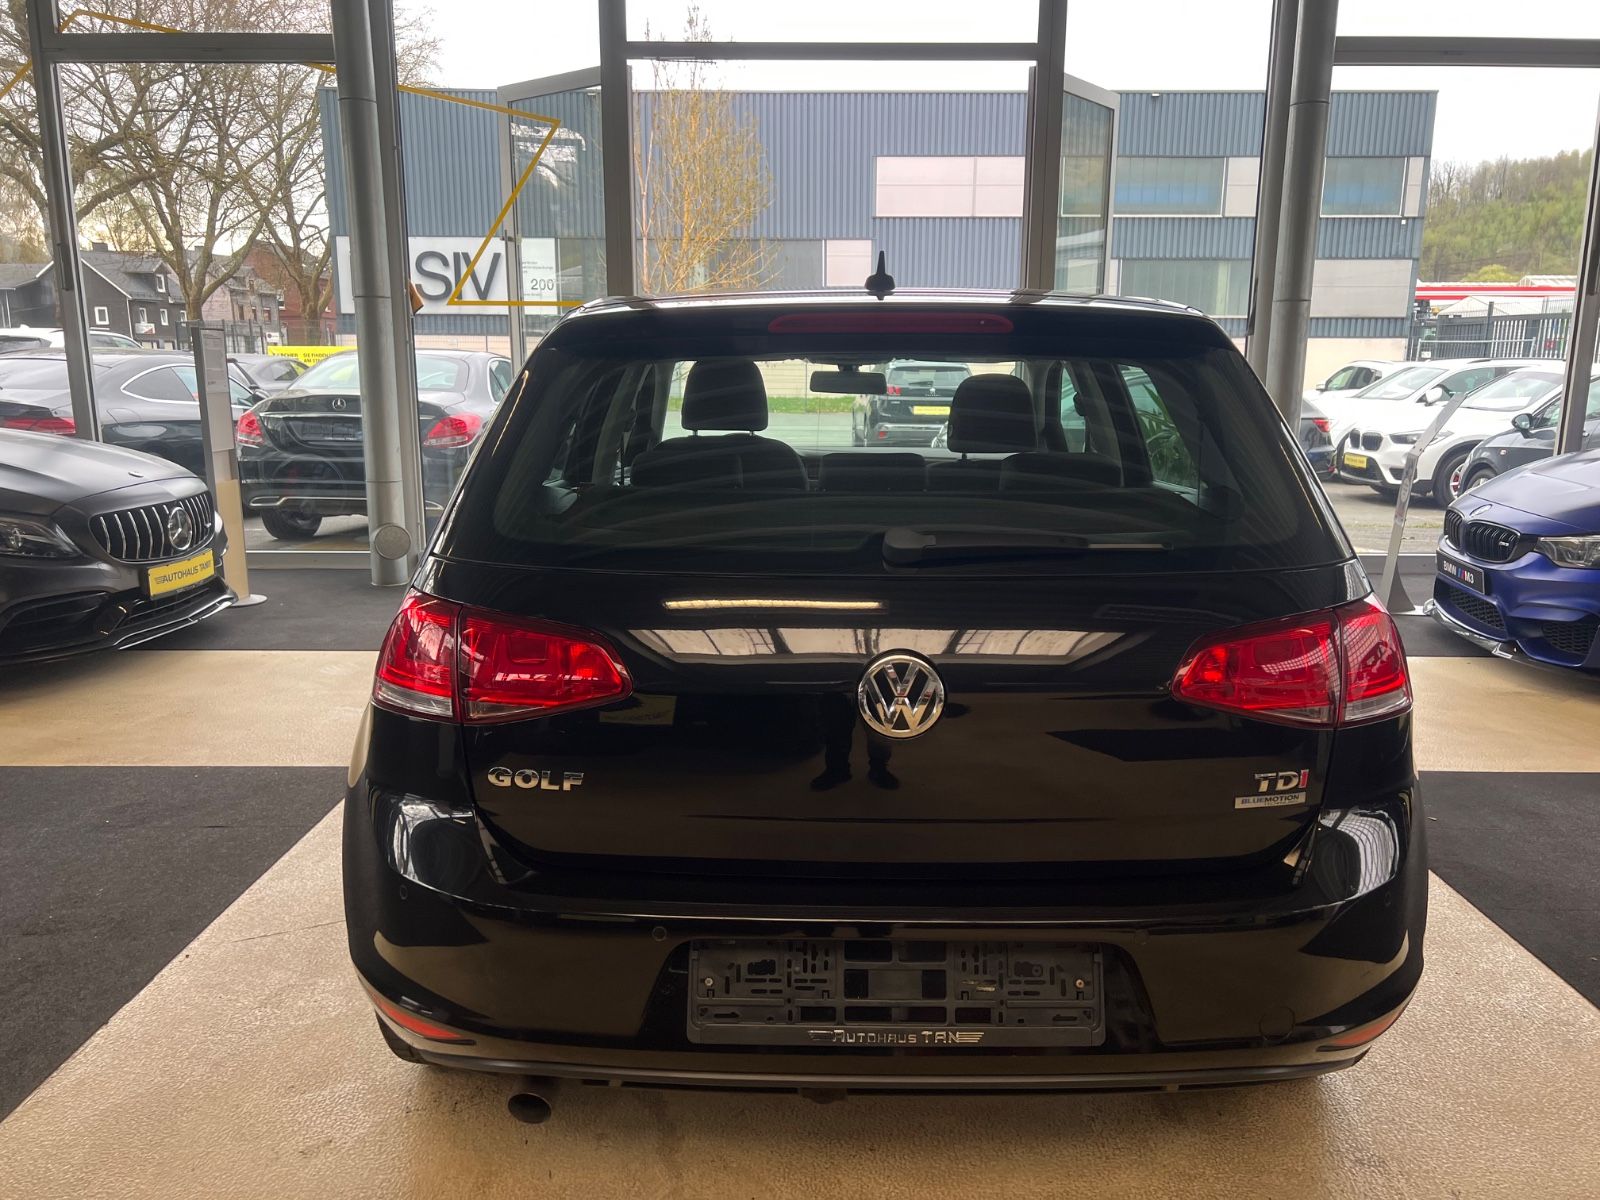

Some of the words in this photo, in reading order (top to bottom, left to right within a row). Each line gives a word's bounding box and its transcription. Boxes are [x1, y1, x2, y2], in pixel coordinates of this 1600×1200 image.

[415, 250, 502, 301] SIV
[530, 278, 555, 291] 200
[162, 565, 199, 584] AUTOHAUS
[1443, 560, 1457, 576] BMW
[487, 766, 585, 791] GOLF
[1254, 769, 1310, 793] TDI
[1241, 794, 1300, 805] BLUEMOTION
[833, 1029, 917, 1044] AUTOHAUS
[921, 1031, 960, 1044] TAN
